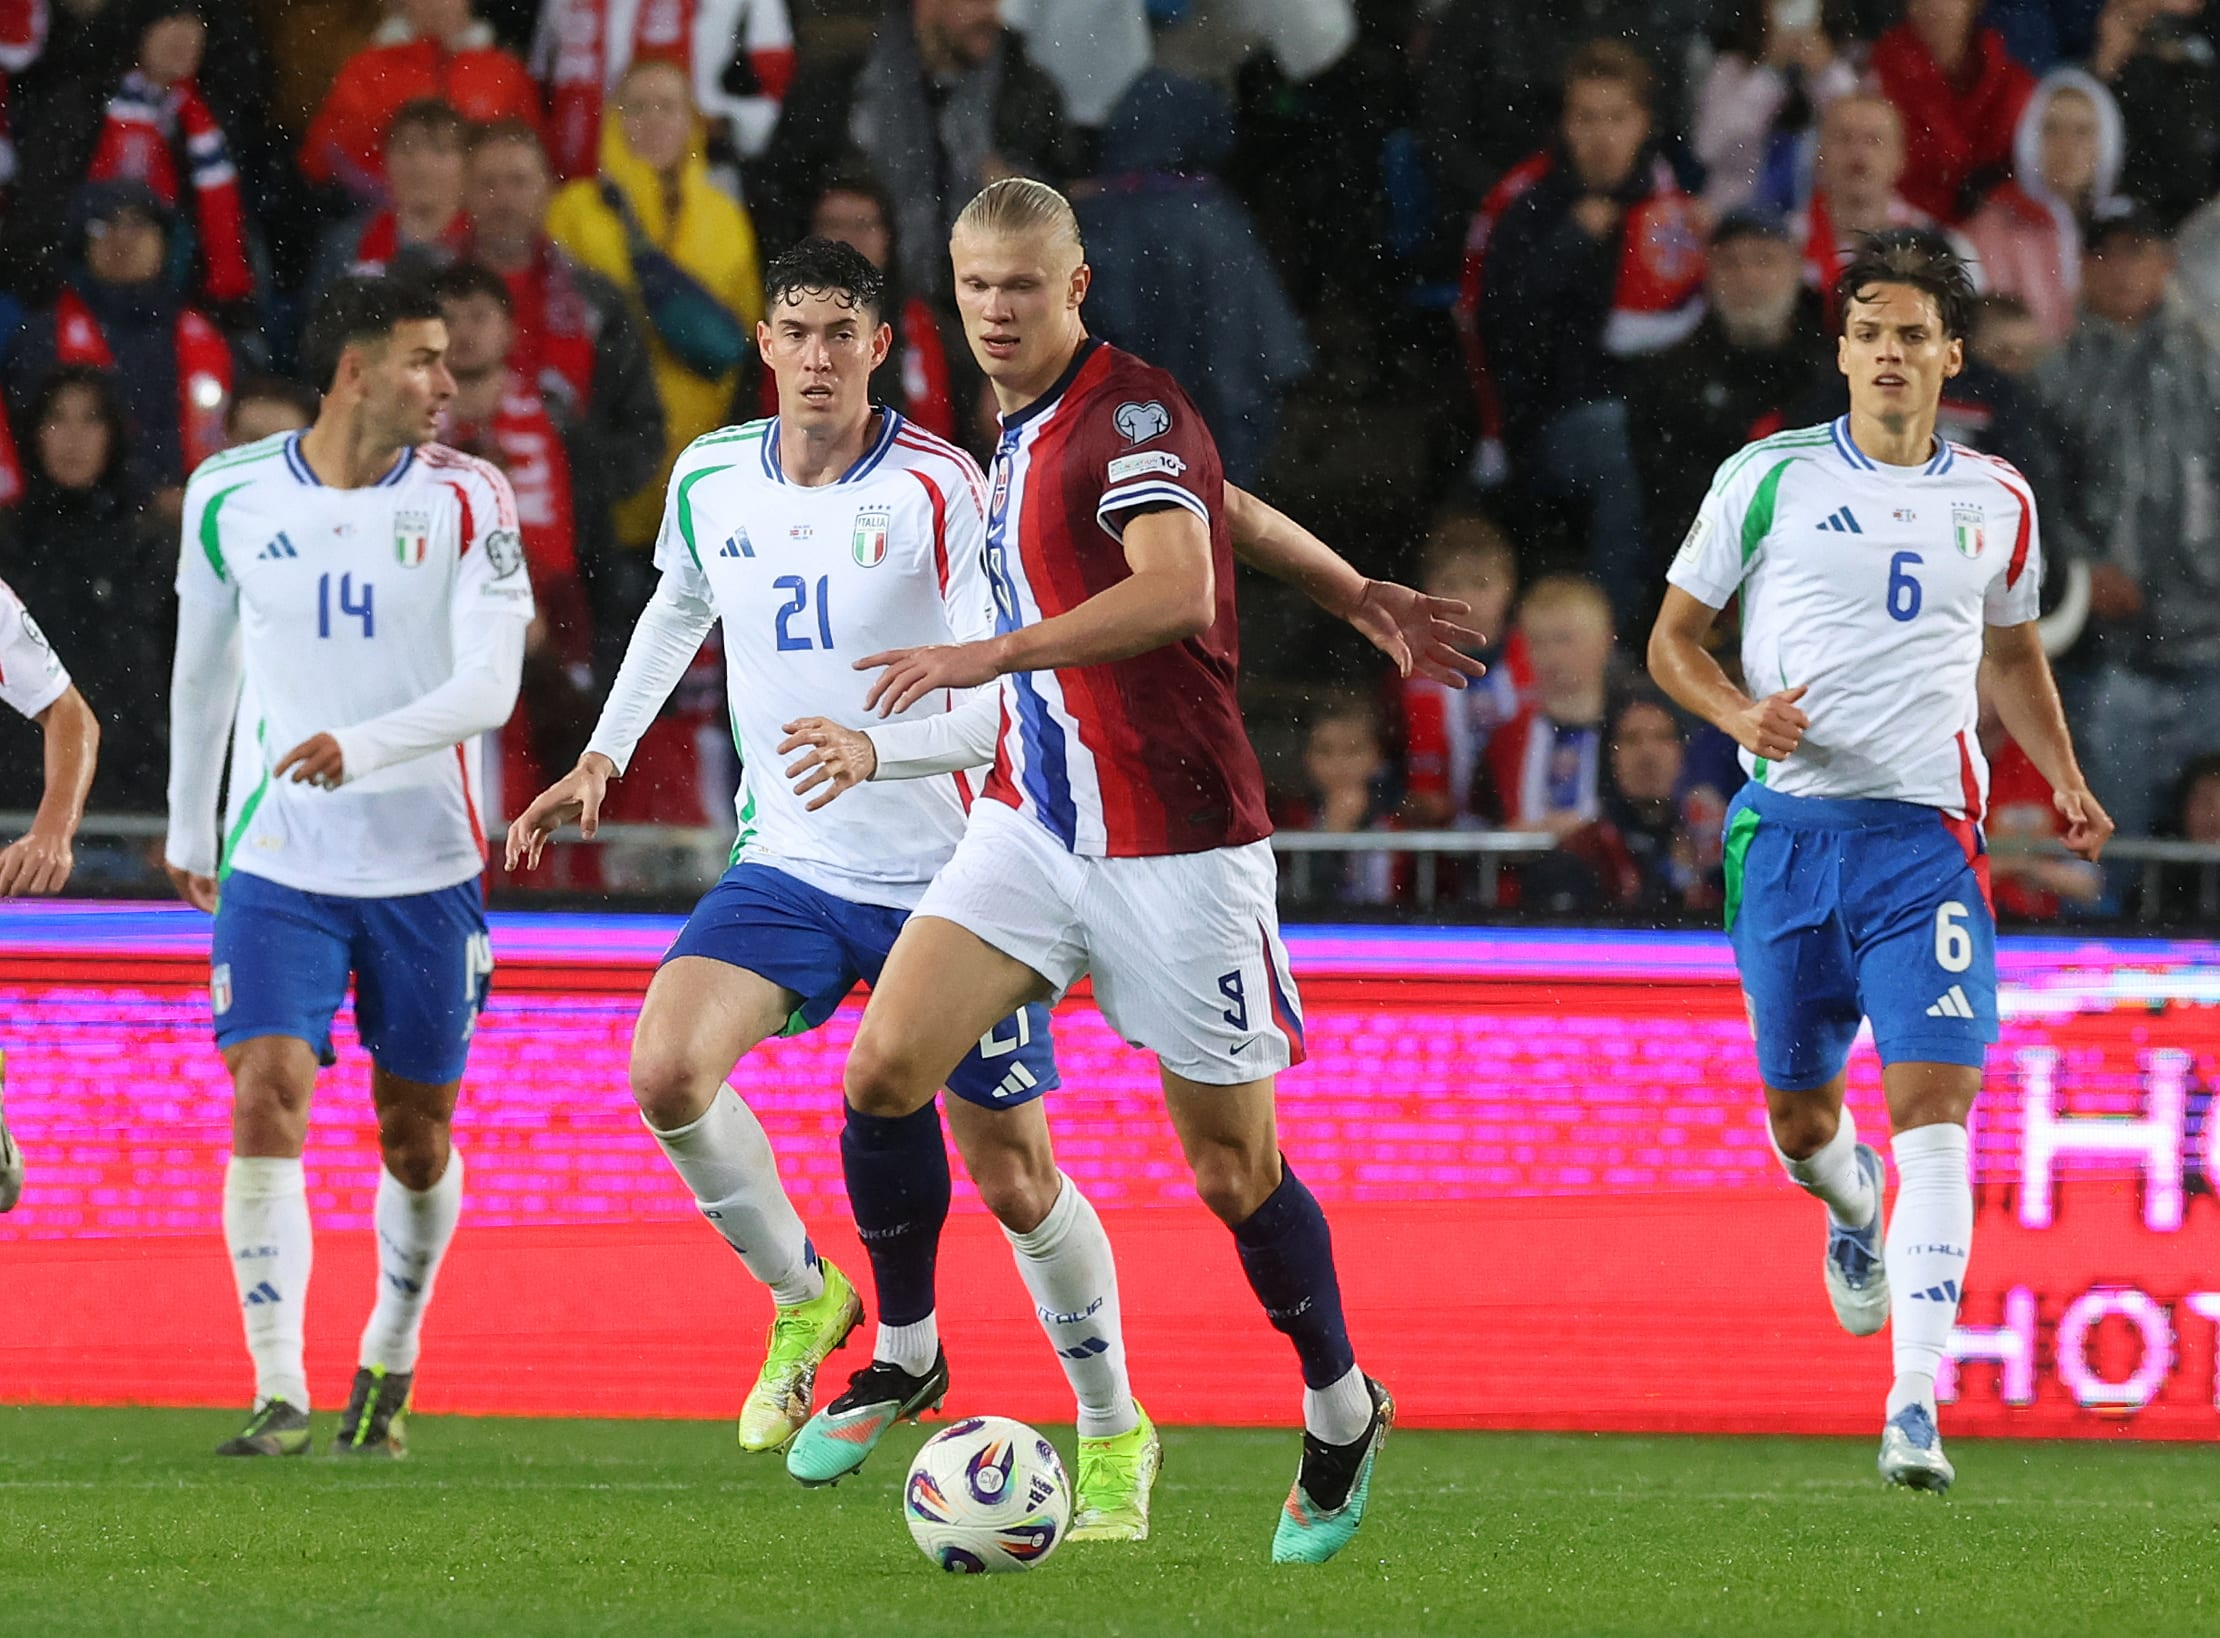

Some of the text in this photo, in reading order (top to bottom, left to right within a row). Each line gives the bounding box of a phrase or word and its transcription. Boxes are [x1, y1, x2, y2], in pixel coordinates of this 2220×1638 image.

[858, 516, 886, 528] ITALIA
[318, 572, 374, 638] 14
[772, 574, 834, 651] 21
[1886, 550, 1924, 622] 6
[1934, 900, 1972, 973] 6
[1217, 968, 1248, 1032] 9
